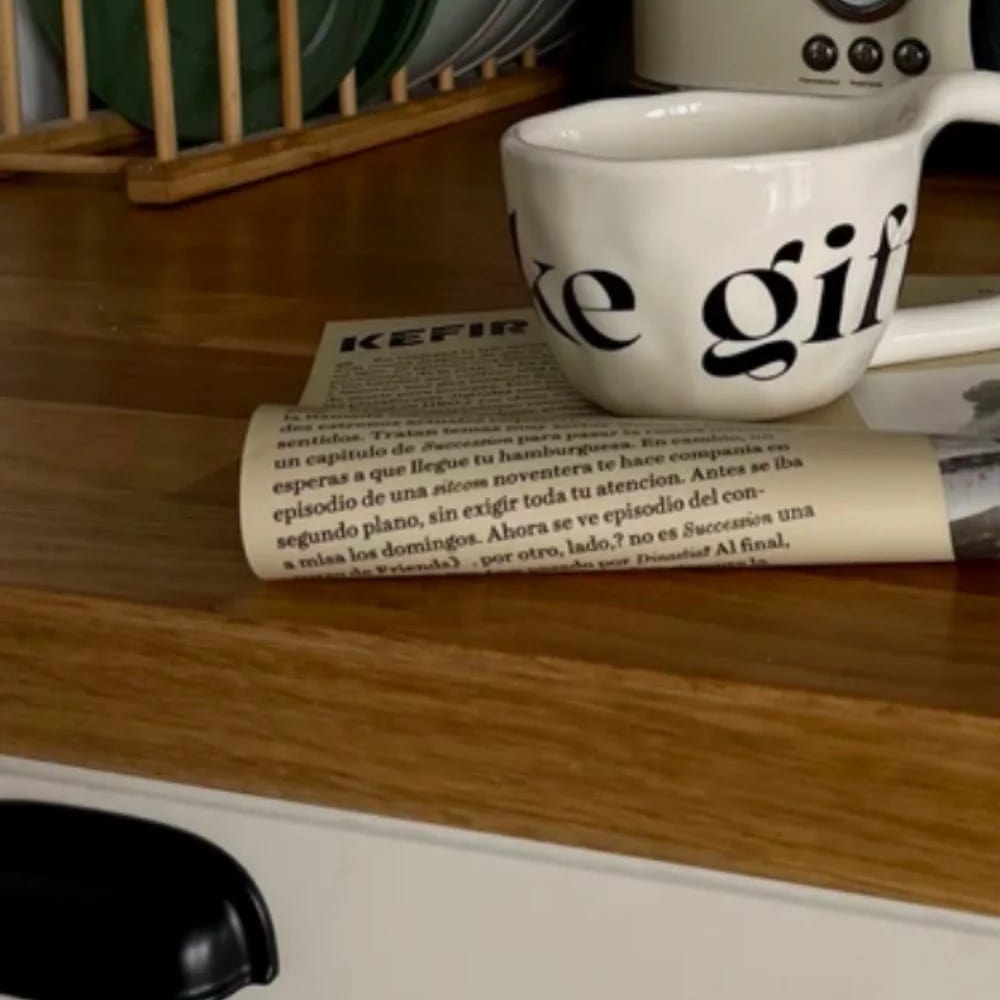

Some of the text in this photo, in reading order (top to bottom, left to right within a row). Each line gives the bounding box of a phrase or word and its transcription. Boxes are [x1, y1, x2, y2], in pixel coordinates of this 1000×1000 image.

[702, 203, 914, 382] gif
[340, 319, 529, 353] KEFIR
[272, 472, 350, 496] esperas
[353, 469, 366, 483] a
[369, 463, 407, 484] que
[410, 457, 470, 475] llegue
[473, 453, 494, 467] tu
[274, 456, 301, 470] un
[391, 442, 416, 456] de
[272, 494, 358, 525] episodio
[361, 489, 386, 506] de
[389, 486, 429, 502] una
[492, 462, 593, 488] noventera
[597, 458, 617, 472] te
[620, 453, 665, 470] hace
[276, 521, 359, 549] segundo
[362, 515, 425, 541] plano,
[428, 505, 458, 525] sin
[462, 495, 520, 519] exigir
[522, 487, 567, 510] toda
[570, 485, 592, 501] tu
[690, 463, 747, 483] Antes
[751, 460, 770, 474] se
[773, 455, 805, 471] iba
[282, 486, 765, 571] a misa los domingos. Ahora se ve episodio del con-
[480, 552, 513, 568] por
[629, 530, 655, 546] no
[657, 527, 679, 542] es
[777, 503, 816, 523] una
[715, 539, 738, 556] Al
[740, 531, 791, 553] final,
